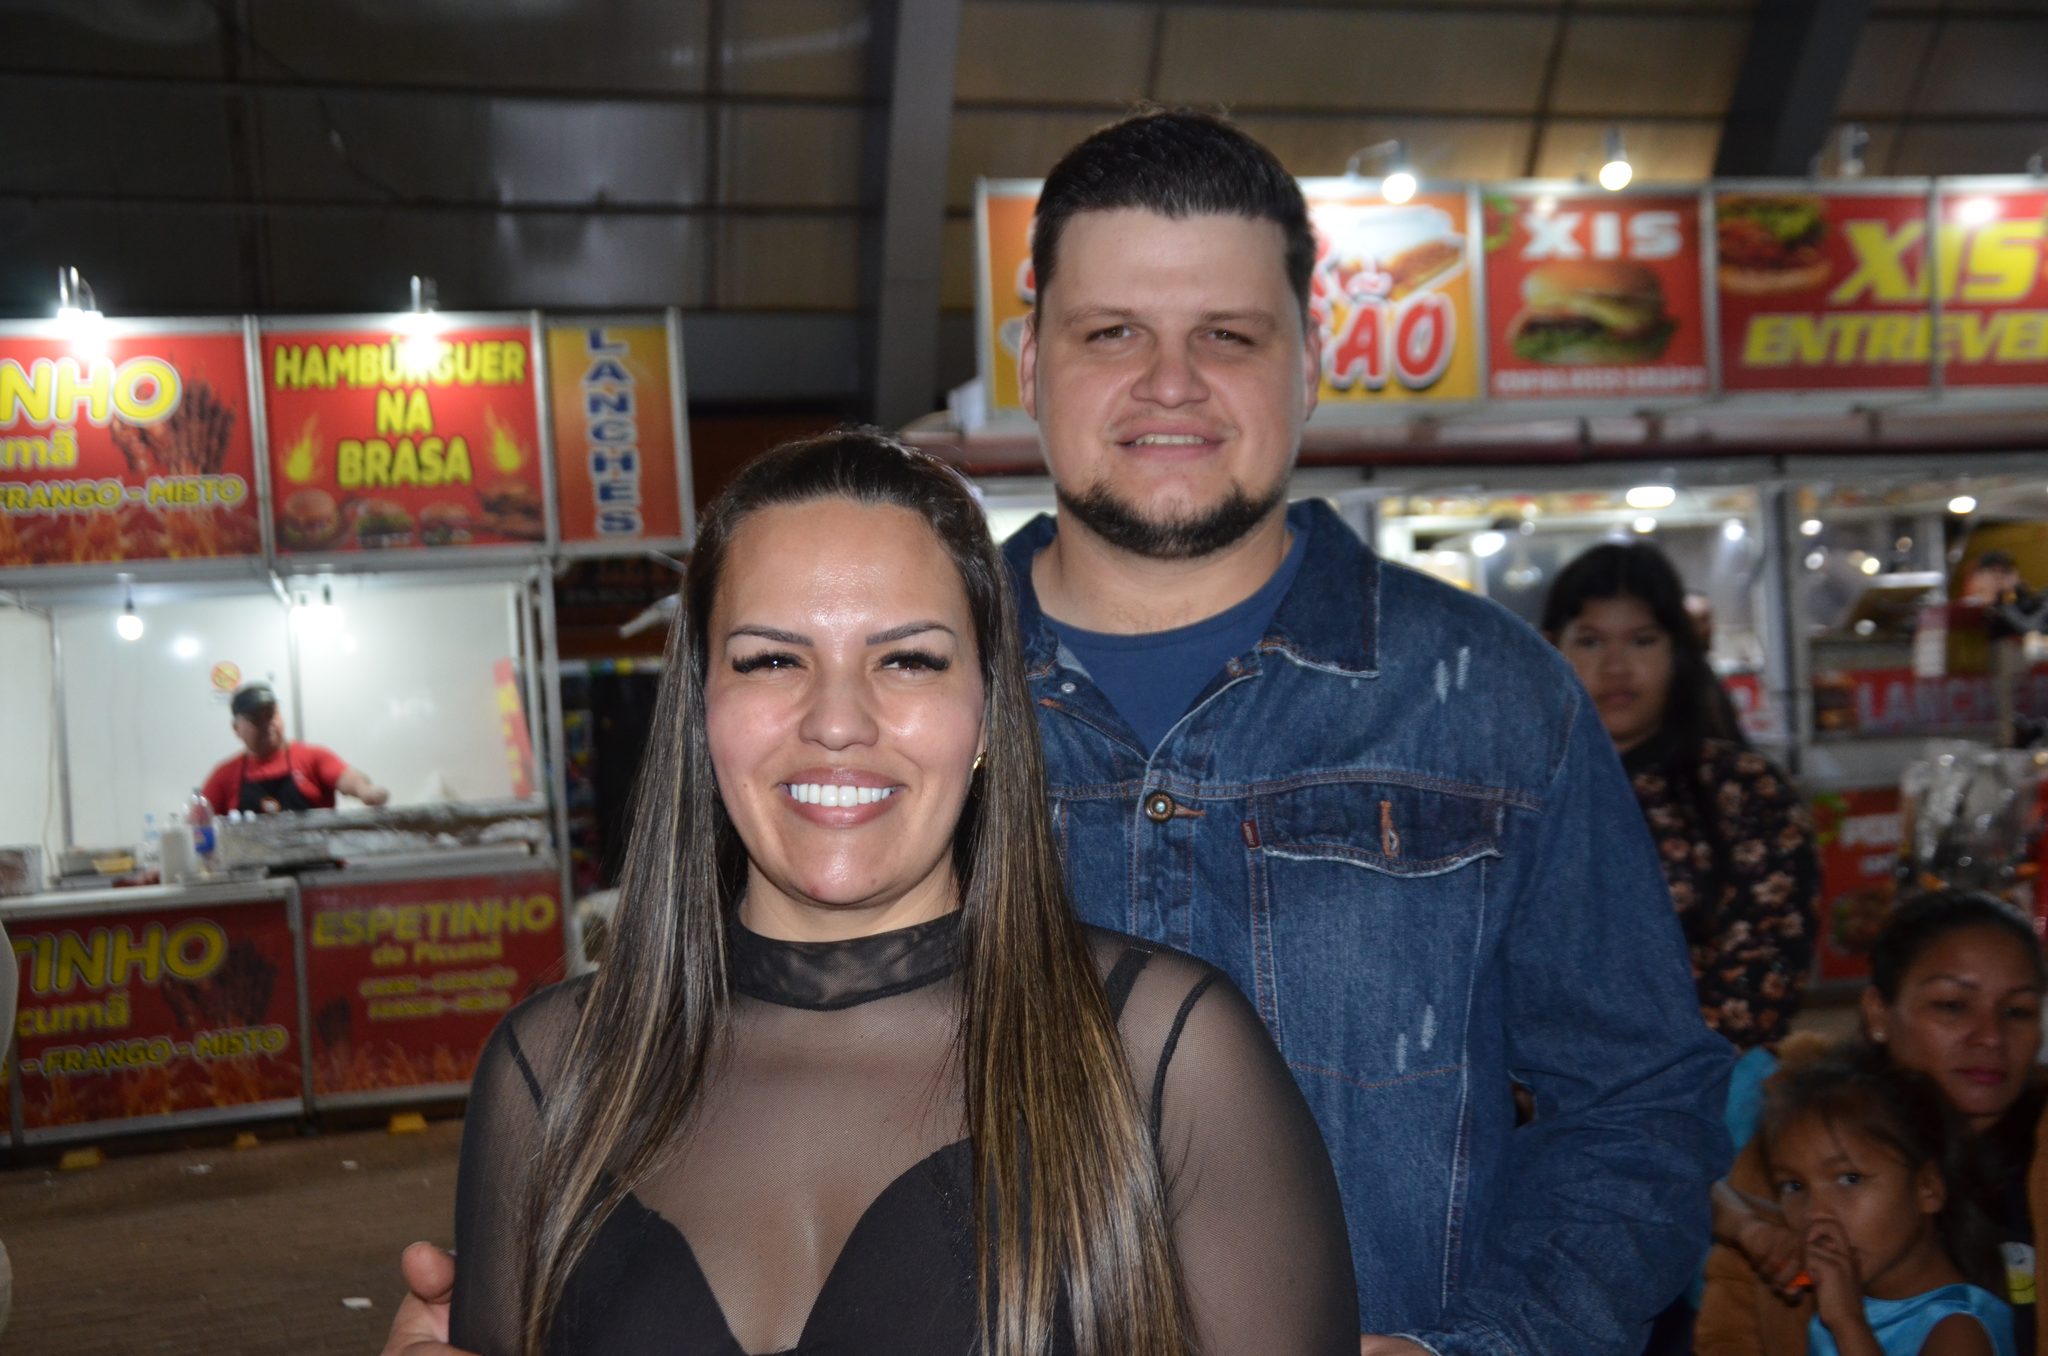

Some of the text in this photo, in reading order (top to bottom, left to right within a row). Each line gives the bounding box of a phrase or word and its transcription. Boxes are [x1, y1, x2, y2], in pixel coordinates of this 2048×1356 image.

[1521, 209, 1685, 262] XIS
[1830, 219, 2045, 303] XIS
[376, 386, 434, 434] NA
[583, 327, 643, 537] LANCHES
[0, 426, 79, 470] mã
[337, 434, 473, 490] BRASA
[147, 474, 247, 508] MISTO
[312, 894, 556, 947] ESPETINHO
[43, 1036, 173, 1075] FRANGO
[194, 1025, 290, 1057] MISTO
